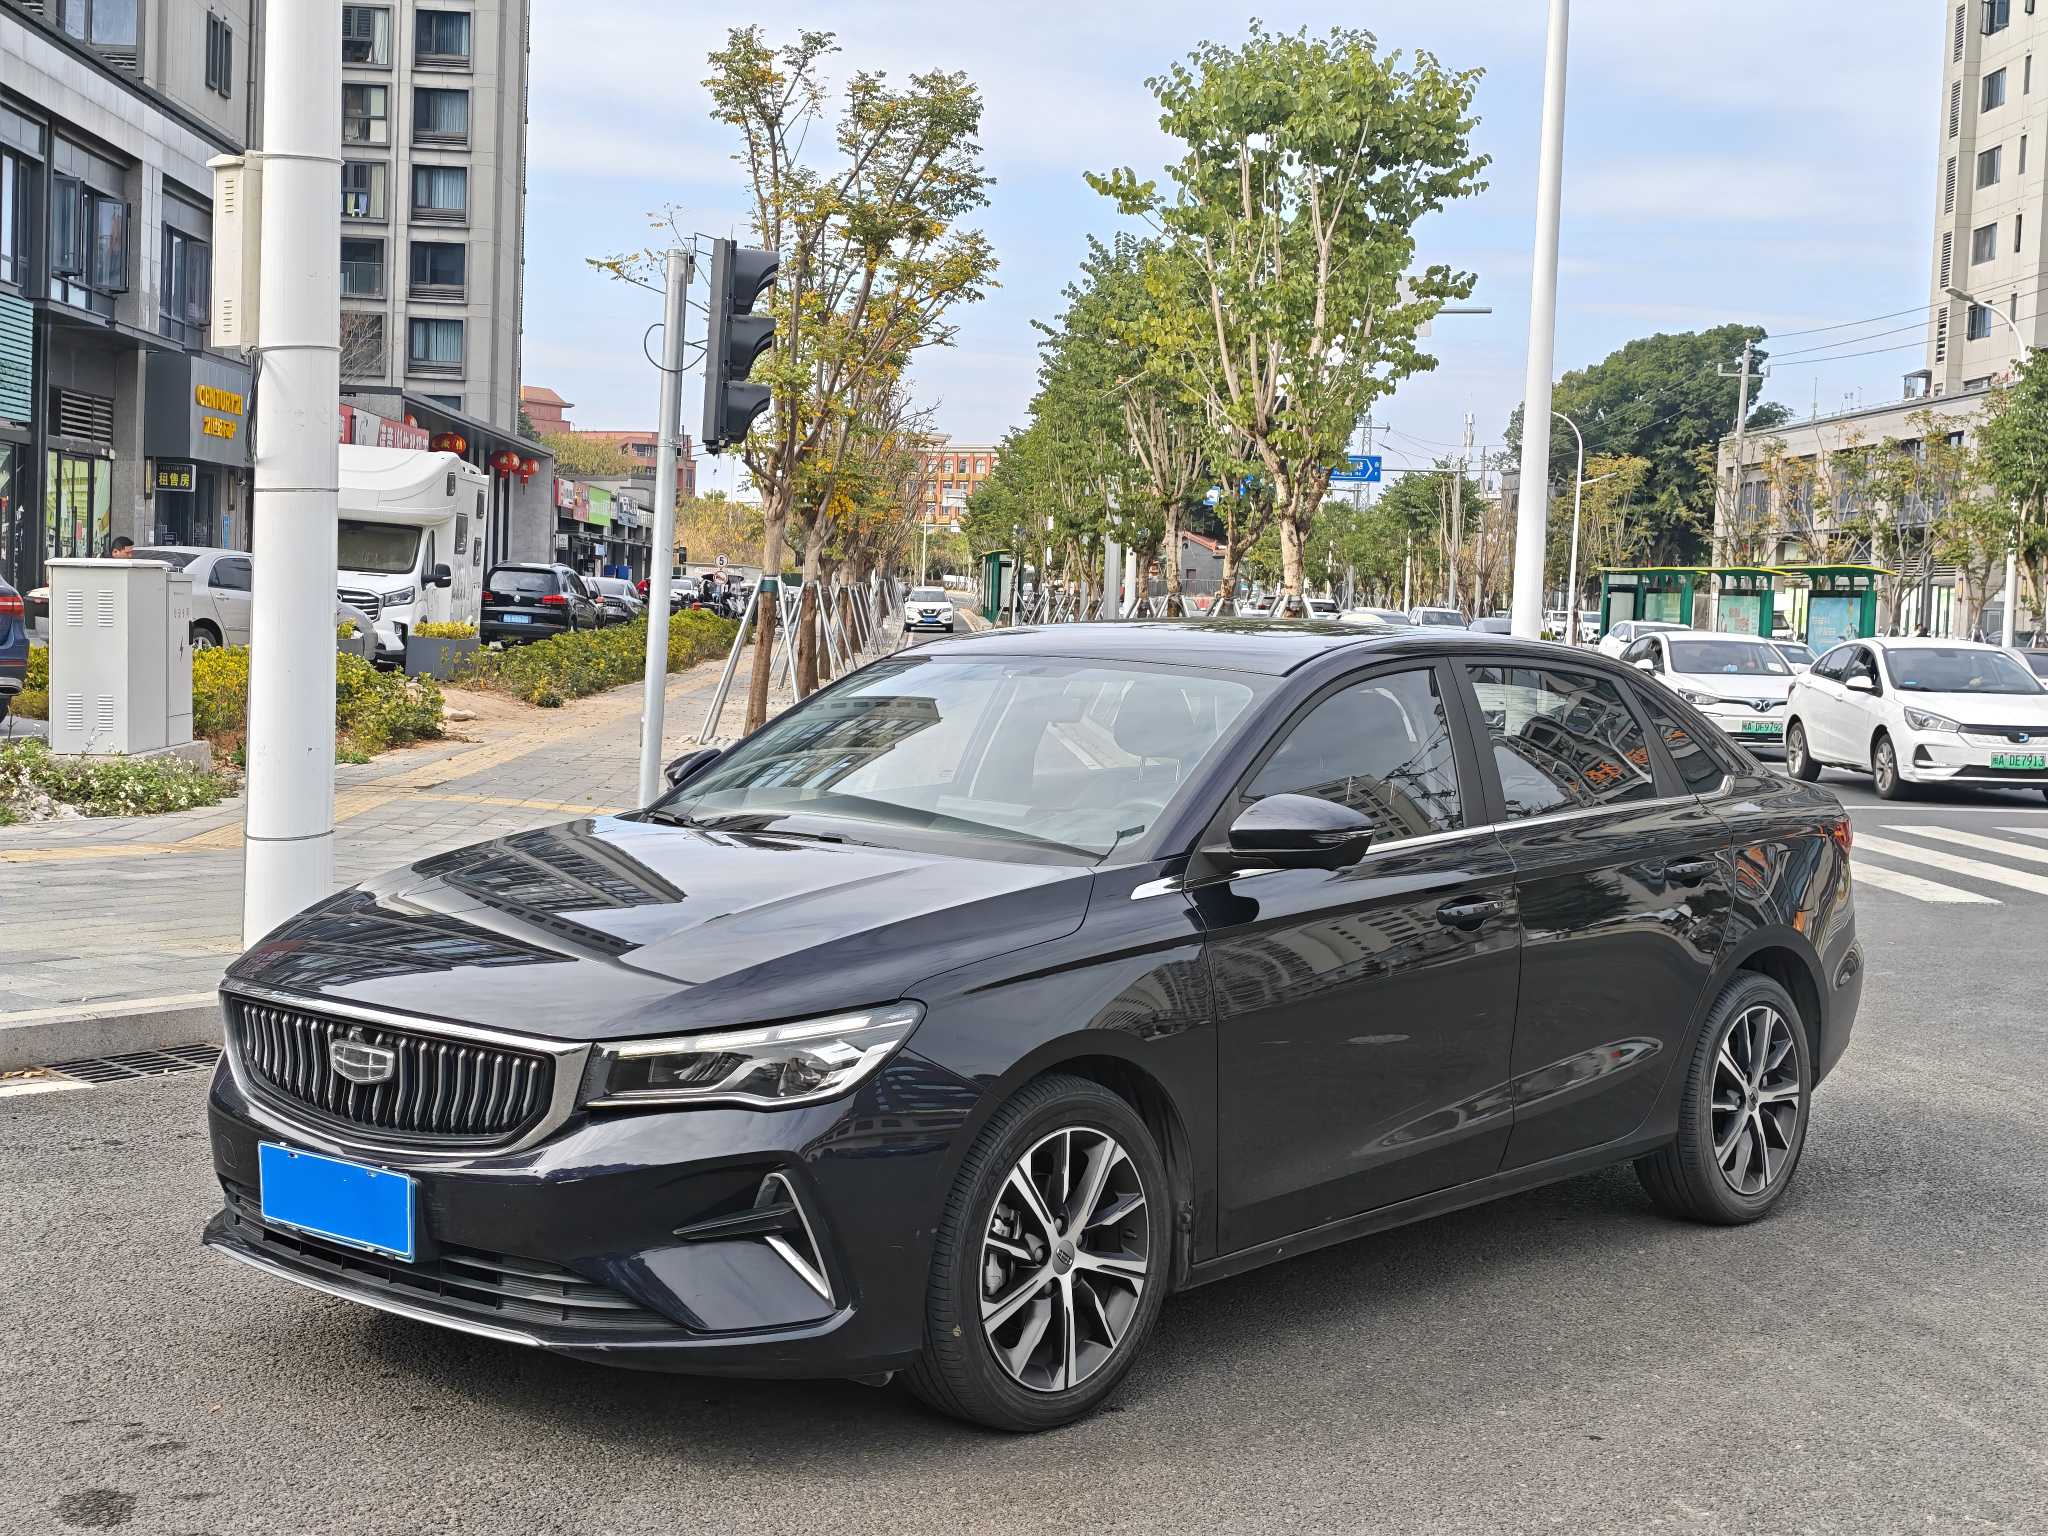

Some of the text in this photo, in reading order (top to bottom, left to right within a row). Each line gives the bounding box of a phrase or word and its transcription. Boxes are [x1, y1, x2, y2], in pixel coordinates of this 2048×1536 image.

[159, 472, 190, 487] 租售房
[719, 556, 724, 566] 5
